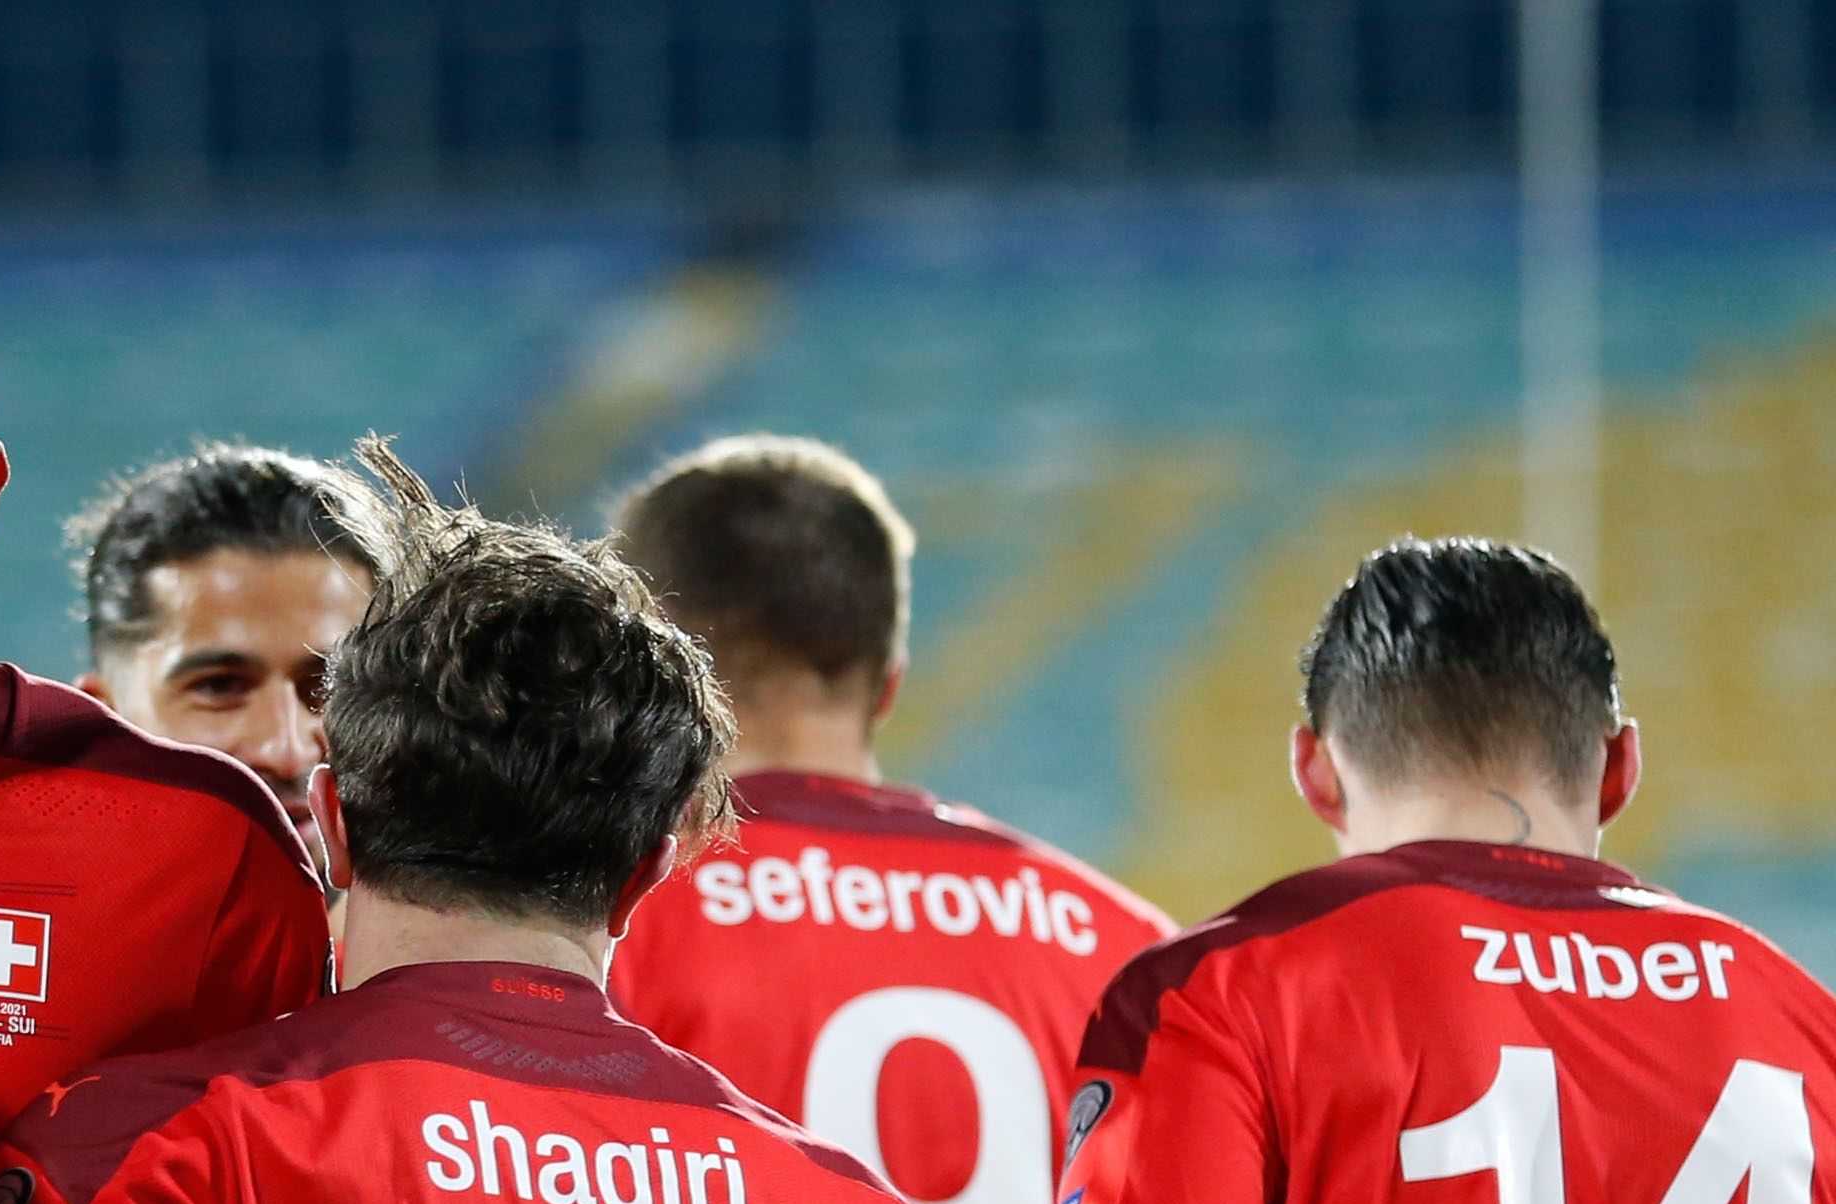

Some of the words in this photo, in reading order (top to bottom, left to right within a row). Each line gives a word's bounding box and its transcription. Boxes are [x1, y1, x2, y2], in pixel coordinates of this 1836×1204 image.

[694, 846, 1098, 957] seferovic
[1460, 924, 1735, 1002] zuber
[8, 1016, 36, 1035] SUI
